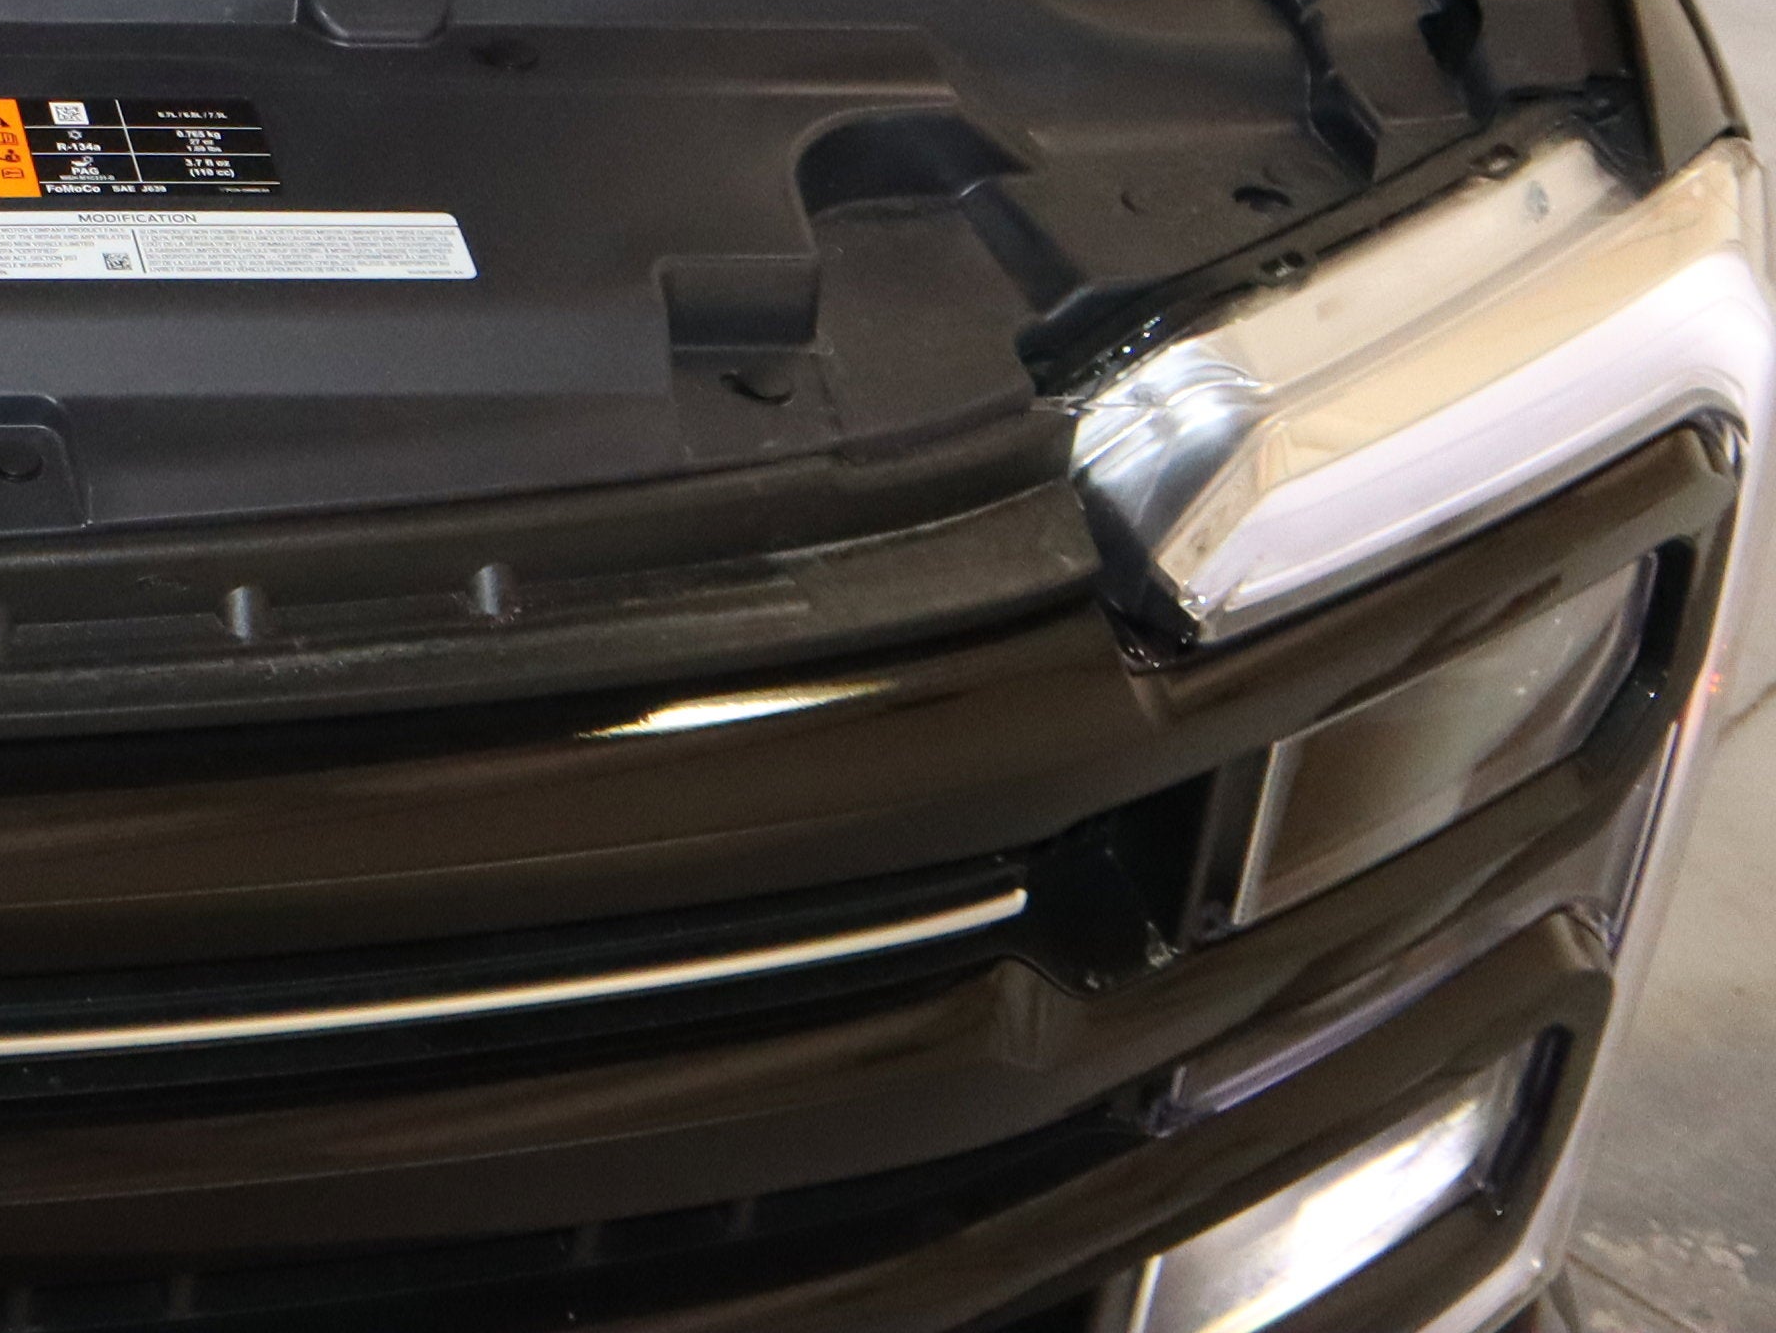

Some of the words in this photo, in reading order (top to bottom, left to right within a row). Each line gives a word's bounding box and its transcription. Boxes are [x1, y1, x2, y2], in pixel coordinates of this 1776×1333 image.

[207, 130, 222, 140] kg
[56, 142, 102, 152] R-134a
[185, 158, 203, 167] 3.7
[71, 167, 100, 175] PAG
[189, 168, 215, 178] (110
[216, 168, 235, 178] cc)
[46, 184, 102, 193] FoMoCo
[112, 185, 136, 193] SAE
[78, 213, 198, 224] MODIFICATION
